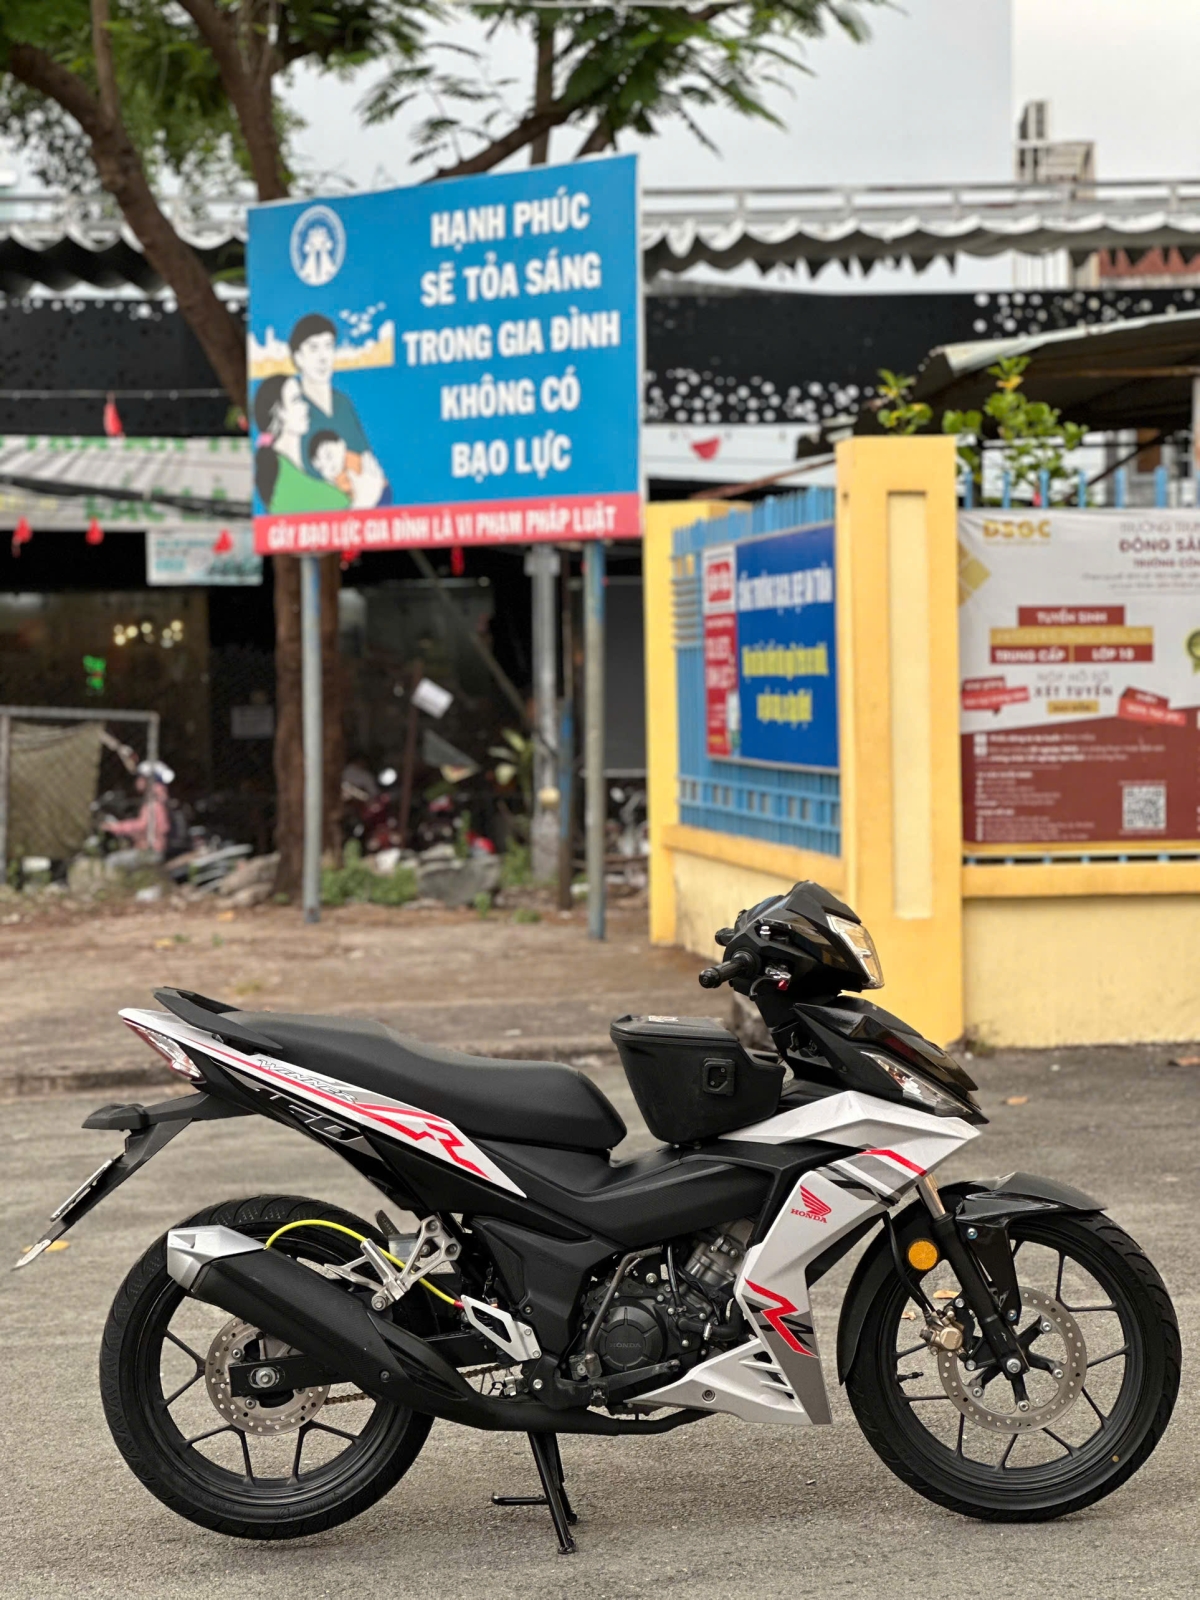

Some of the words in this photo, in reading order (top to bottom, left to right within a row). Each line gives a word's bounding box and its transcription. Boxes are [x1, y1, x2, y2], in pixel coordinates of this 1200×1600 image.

[430, 205, 506, 252] HẠNH
[512, 186, 590, 238] PHÚC
[420, 263, 456, 307] SẼ
[463, 252, 519, 302] TỎA
[525, 248, 601, 295] SÁNG
[402, 323, 492, 366] TRONG
[497, 319, 545, 358] GIA
[550, 305, 620, 352] ĐÌNH
[440, 373, 535, 421] KHÔNG
[540, 366, 581, 413] CÓ
[451, 437, 508, 482] BẠO
[515, 429, 572, 480] LỰC
[298, 521, 330, 551] BẠO
[331, 516, 362, 551] LỰC
[364, 517, 390, 543] GIA
[391, 511, 430, 541] ĐÌNH
[432, 508, 453, 541] LÀ
[455, 513, 474, 538] VI
[475, 510, 523, 541] PHẠM
[525, 503, 571, 534] PHÁP
[573, 500, 617, 537] LUẬT
[1078, 610, 1108, 623] SINH
[995, 649, 1036, 663] TRUNG
[790, 1208, 828, 1224] HONDA
